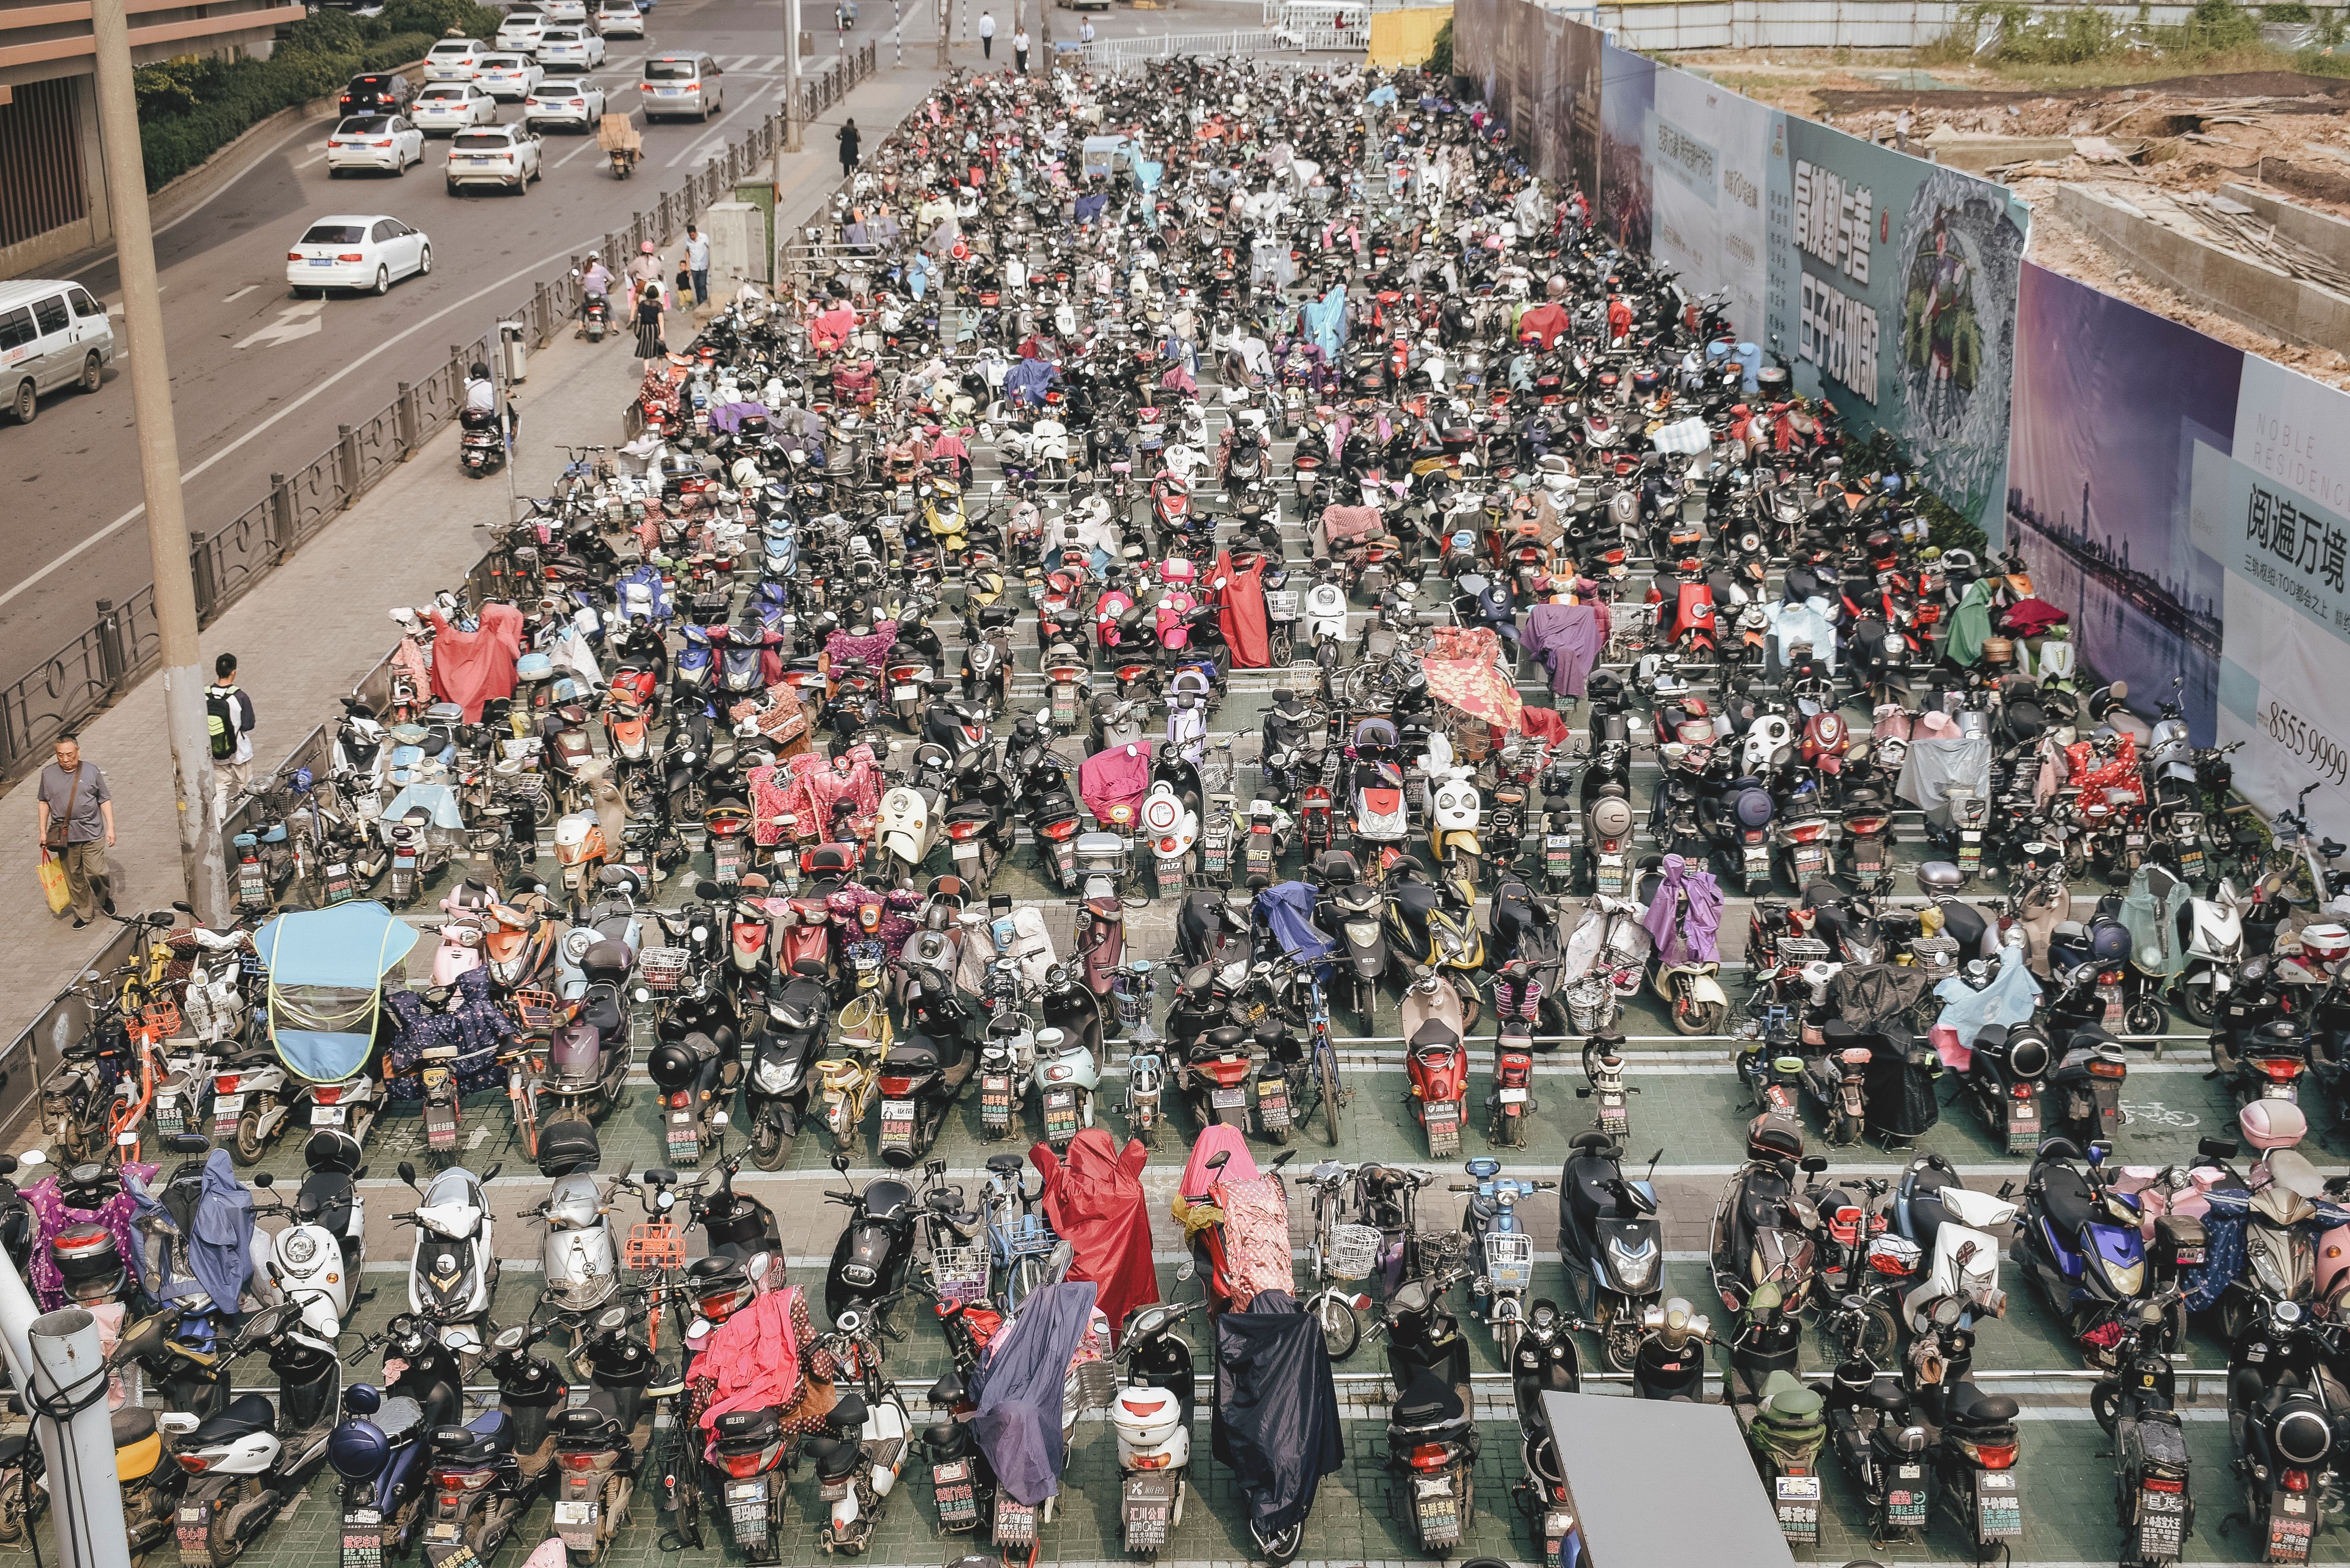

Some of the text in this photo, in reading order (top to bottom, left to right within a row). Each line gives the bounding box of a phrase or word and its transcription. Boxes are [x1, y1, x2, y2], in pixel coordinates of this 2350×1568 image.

[1799, 271, 1880, 407] 日子好如歌
[2256, 412, 2315, 459] NOBLE
[2253, 442, 2350, 513] RESIDENC
[2247, 482, 2347, 594] 阅遍万境
[2270, 701, 2347, 786] 8555 9999
[1247, 849, 1270, 861] 新日
[883, 1121, 912, 1134] 汇川公司
[936, 1484, 973, 1503] 草场门专卖
[2148, 1495, 2175, 1507] 巨龙
[1130, 1507, 1166, 1521] 汇川公司
[1889, 1505, 1926, 1515] 万路达三轮车
[1009, 1513, 1033, 1524] 雅迪
[1422, 1514, 1457, 1528] 绿佳电动车
[176, 1527, 208, 1540] 铁心桥
[1130, 1521, 1142, 1532] 新的
[2273, 1519, 2310, 1537] 合众大卖场
[343, 1535, 381, 1549] 斌记车业
[2283, 1534, 2308, 1546] 雅迪
